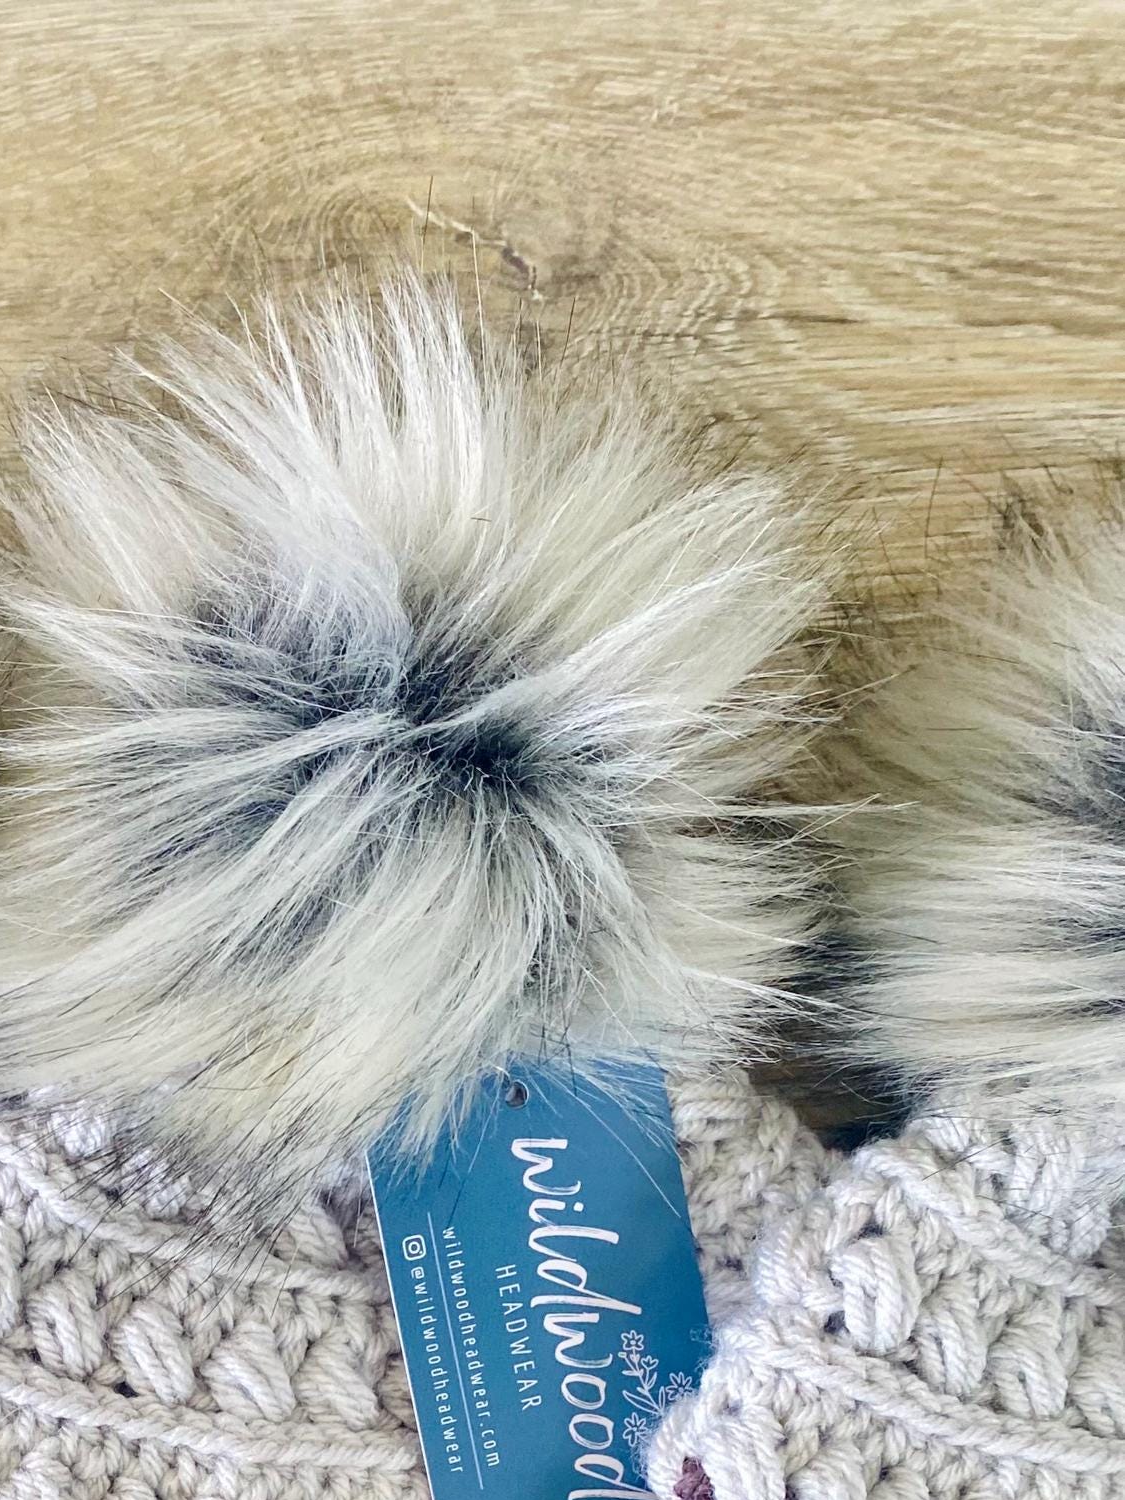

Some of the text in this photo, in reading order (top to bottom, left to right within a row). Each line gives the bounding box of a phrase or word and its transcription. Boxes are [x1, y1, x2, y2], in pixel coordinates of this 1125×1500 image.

[410, 1265, 464, 1474] @wildwoodheadwear
[443, 1227, 500, 1467] wildwoodheadwear.com
[494, 1263, 541, 1411] HEADWEAR
